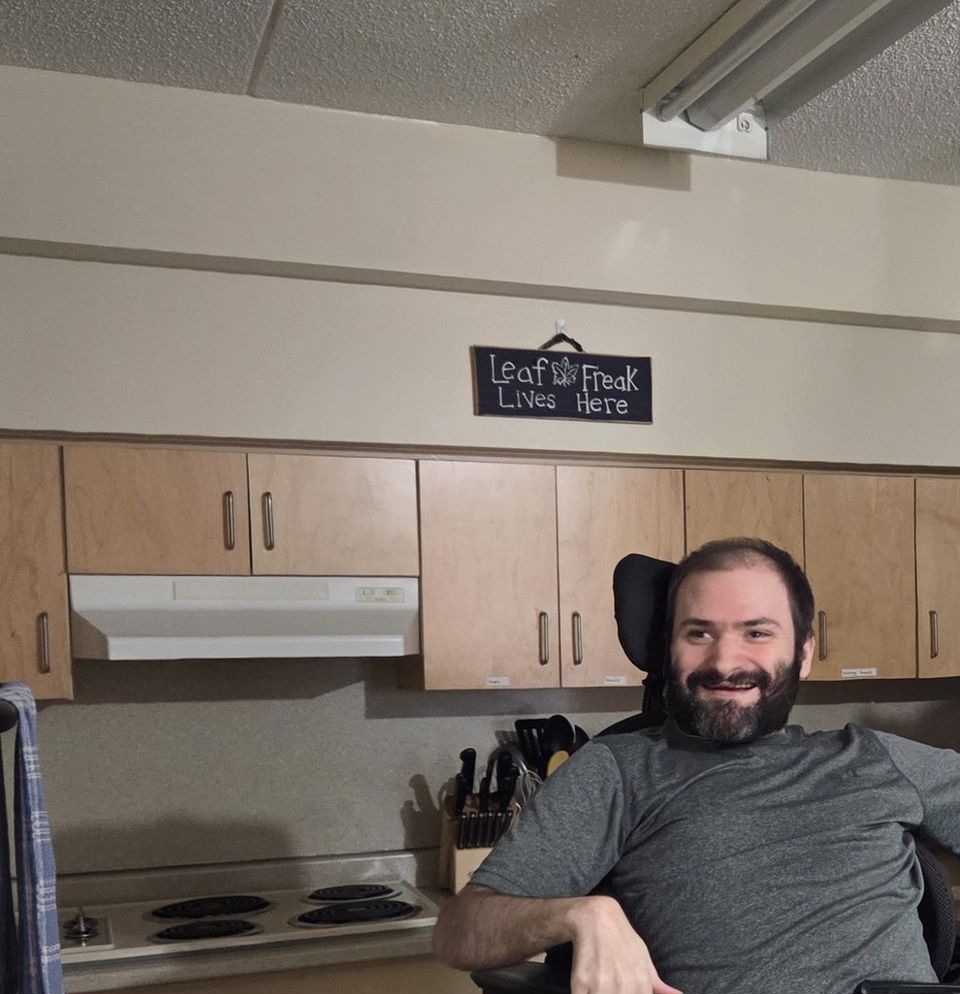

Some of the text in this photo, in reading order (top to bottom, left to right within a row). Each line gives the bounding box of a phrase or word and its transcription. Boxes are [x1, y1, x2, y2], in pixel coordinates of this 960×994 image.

[490, 354, 639, 392] Leaf Freak
[499, 386, 629, 415] Lives Here
